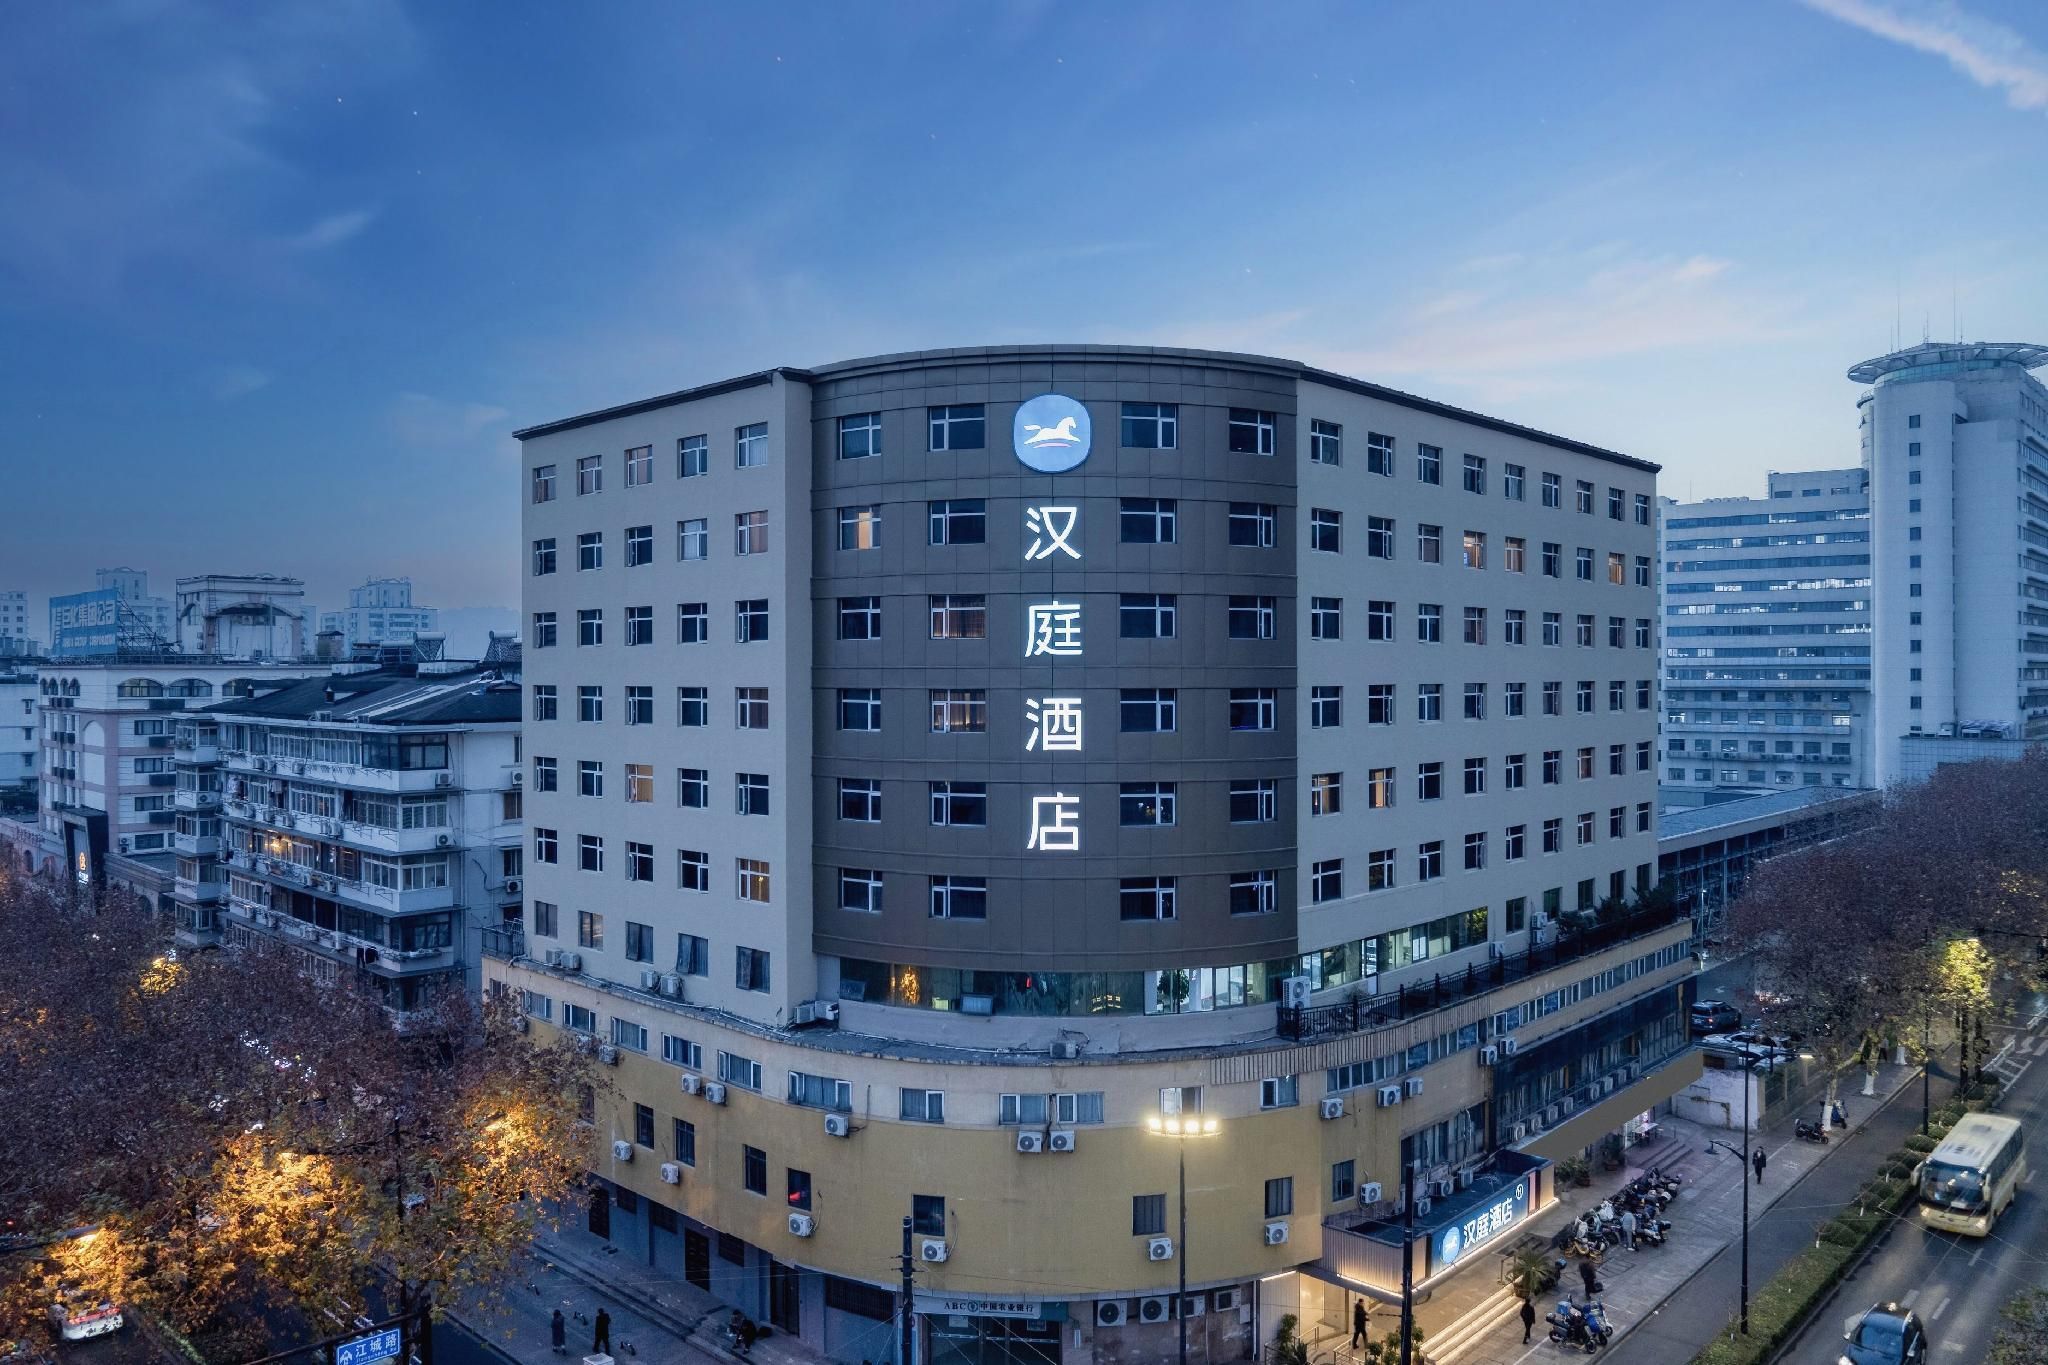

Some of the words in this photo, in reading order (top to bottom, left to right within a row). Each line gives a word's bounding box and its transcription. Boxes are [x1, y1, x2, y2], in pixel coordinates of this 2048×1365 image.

[63, 600, 115, 629] 巨化集团公司
[1024, 506, 1084, 852] 汉庭酒店
[1463, 1197, 1513, 1250] 汉庭酒店
[944, 1302, 966, 1310] ABC
[980, 1301, 1034, 1313] 中国农业银行
[355, 1333, 397, 1358] 江城路
